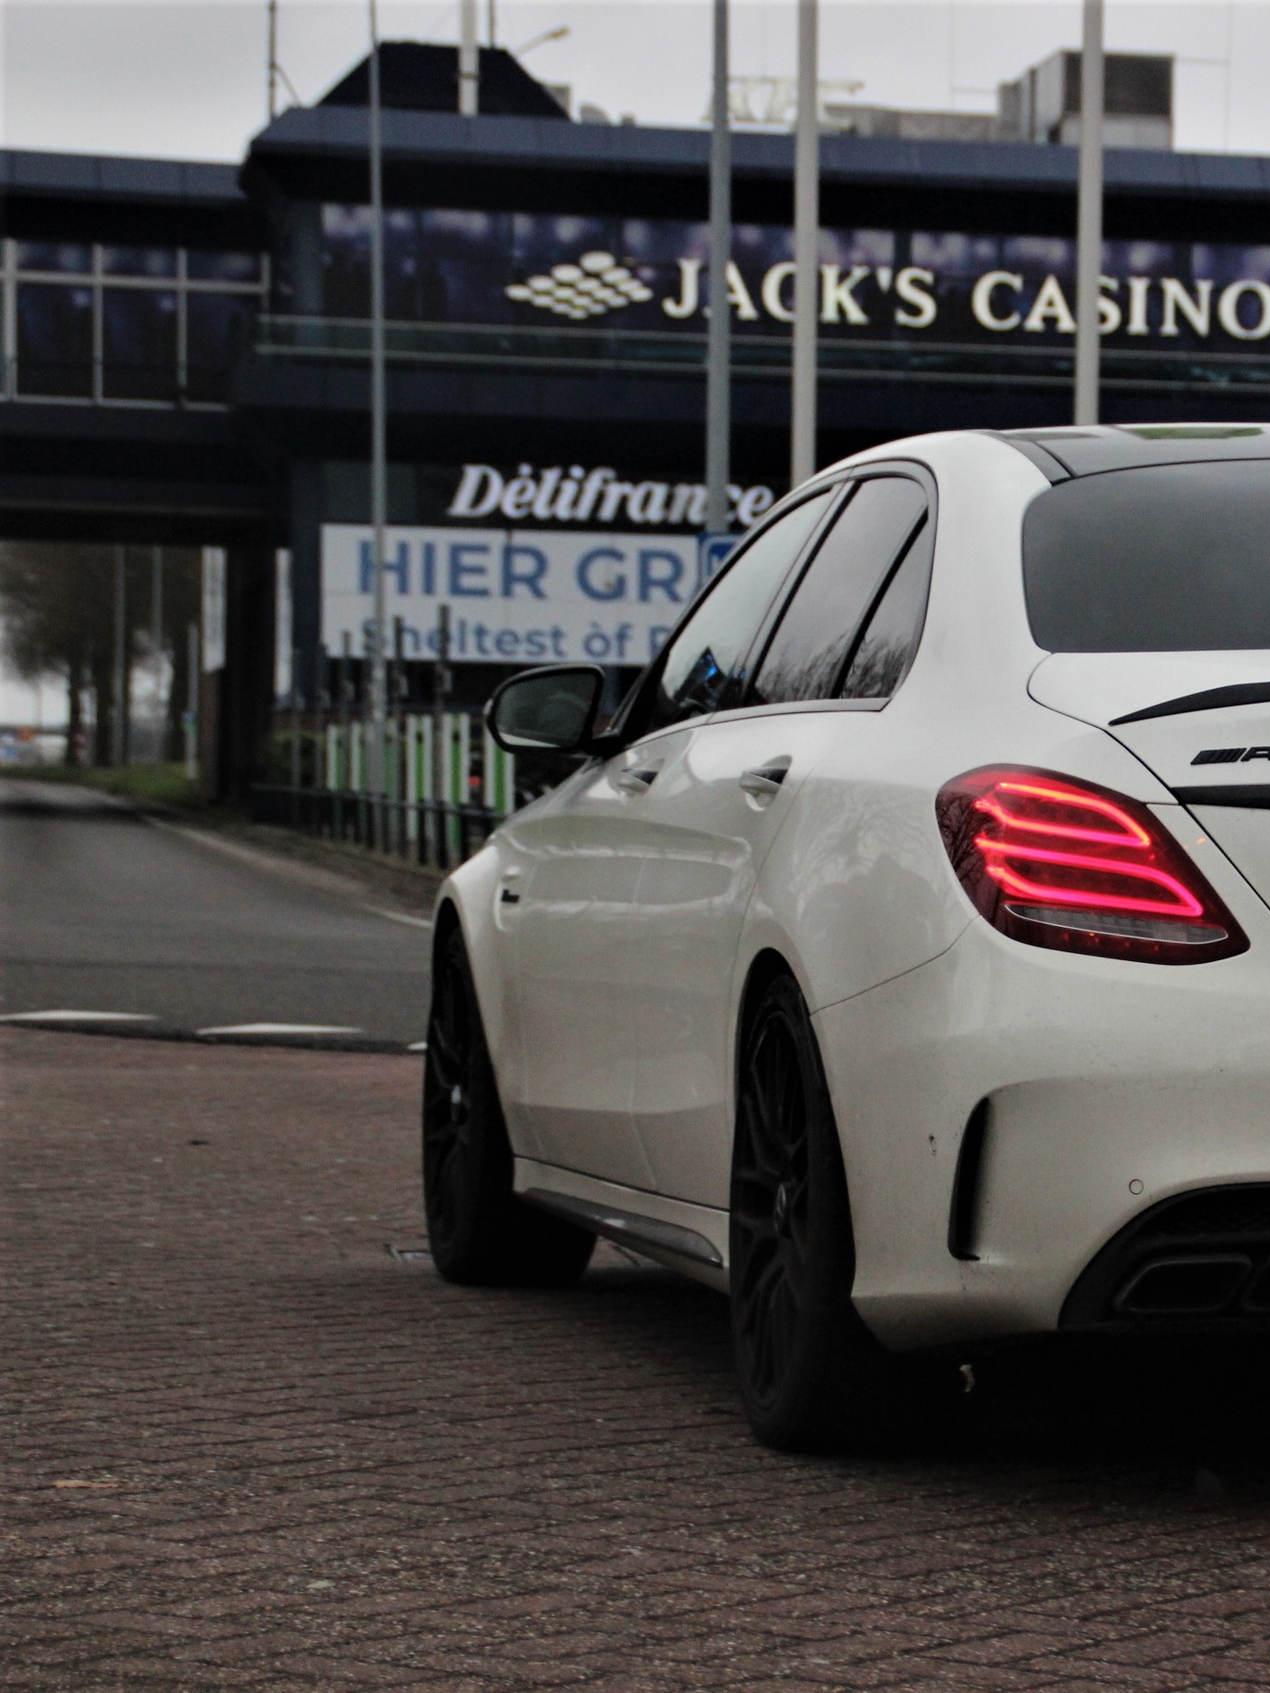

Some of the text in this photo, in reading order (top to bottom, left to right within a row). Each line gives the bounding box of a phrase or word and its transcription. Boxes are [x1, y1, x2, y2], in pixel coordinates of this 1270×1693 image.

[662, 258, 937, 328] JACK'S
[358, 540, 694, 602] HIER GR
